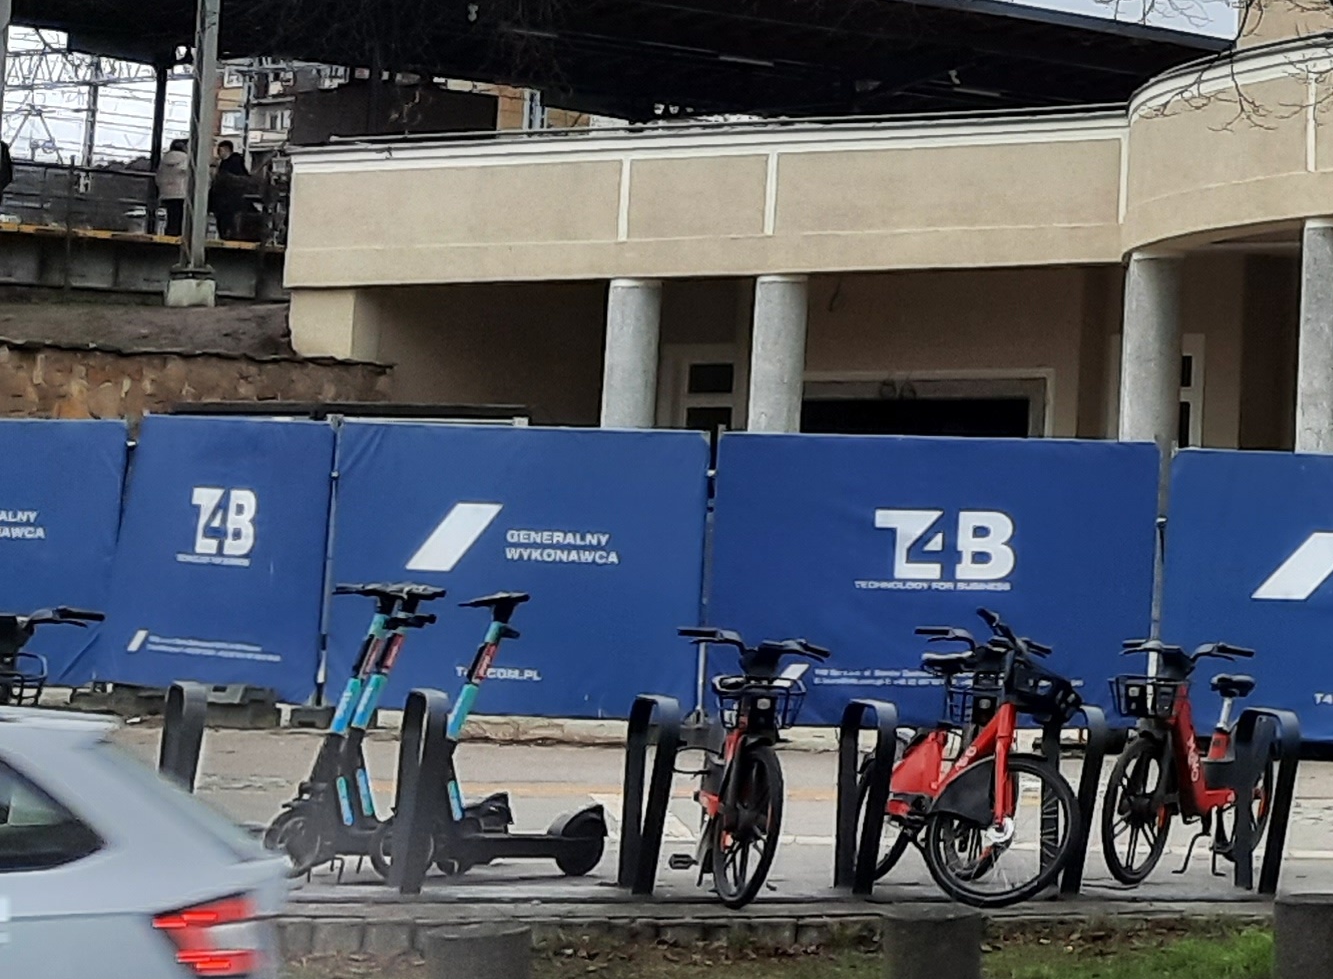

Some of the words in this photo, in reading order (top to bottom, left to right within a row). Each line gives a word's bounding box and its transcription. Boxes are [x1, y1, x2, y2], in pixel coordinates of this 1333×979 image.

[191, 487, 257, 556] T4B
[506, 529, 610, 546] GENERALNY
[505, 547, 619, 565] WYKONAWCA
[875, 509, 1015, 580] T4B
